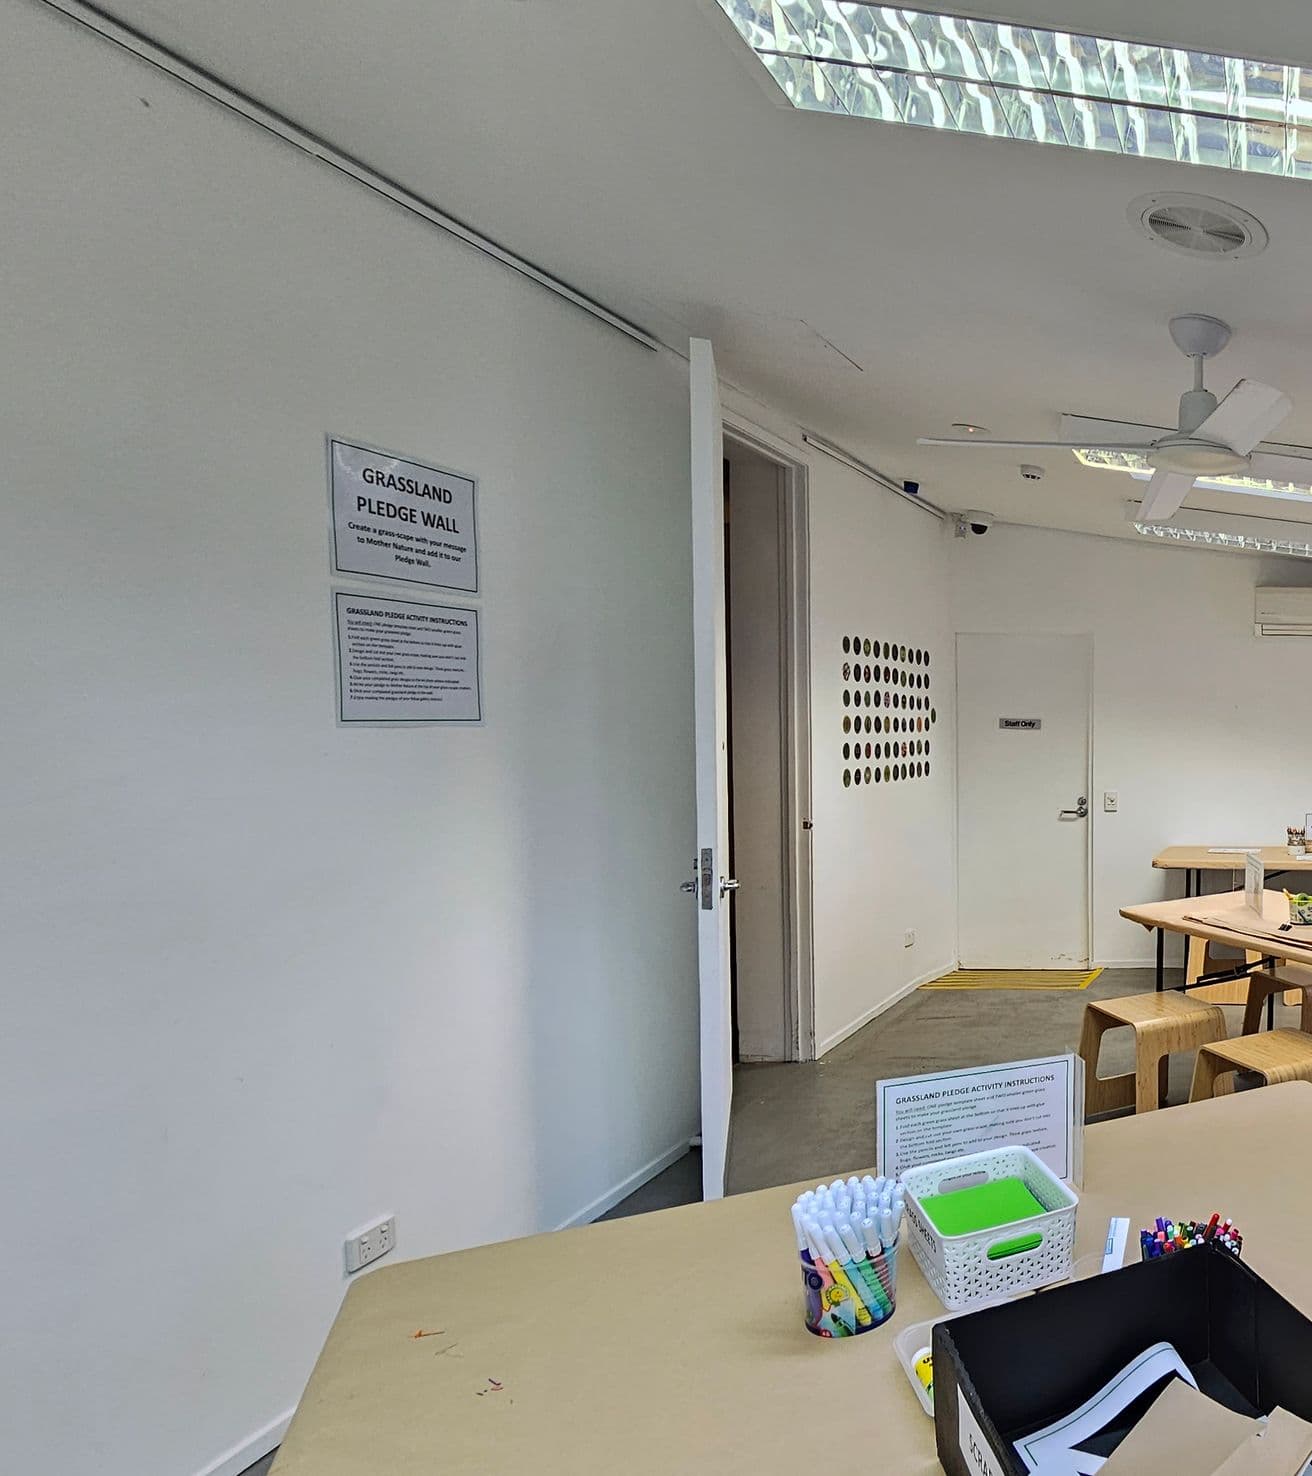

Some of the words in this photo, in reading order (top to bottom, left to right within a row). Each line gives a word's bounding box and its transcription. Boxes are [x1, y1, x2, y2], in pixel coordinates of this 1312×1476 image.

[362, 467, 453, 504] GRASSLAND
[356, 495, 418, 524] PLEDGE
[420, 510, 460, 534] WALL
[347, 521, 372, 533] Create
[429, 540, 442, 549] your
[442, 541, 467, 554] message
[356, 536, 366, 544] to
[366, 537, 392, 549] Mother
[392, 542, 414, 553] Nature
[394, 554, 415, 566] Pledge
[346, 607, 384, 618] GRASSLAND
[384, 611, 406, 621] PLEDGE
[406, 614, 429, 623] ACTIVITY
[429, 616, 468, 627] INSTRUCTIONS
[1020, 719, 1036, 728] Only
[895, 1092, 941, 1105] GRASSLAND
[941, 1087, 970, 1098] PLEDGE
[971, 1082, 1003, 1093] ACTIVITY
[1004, 1074, 1055, 1089] INSTRUCTIONS
[969, 1432, 993, 1476] SCRA
